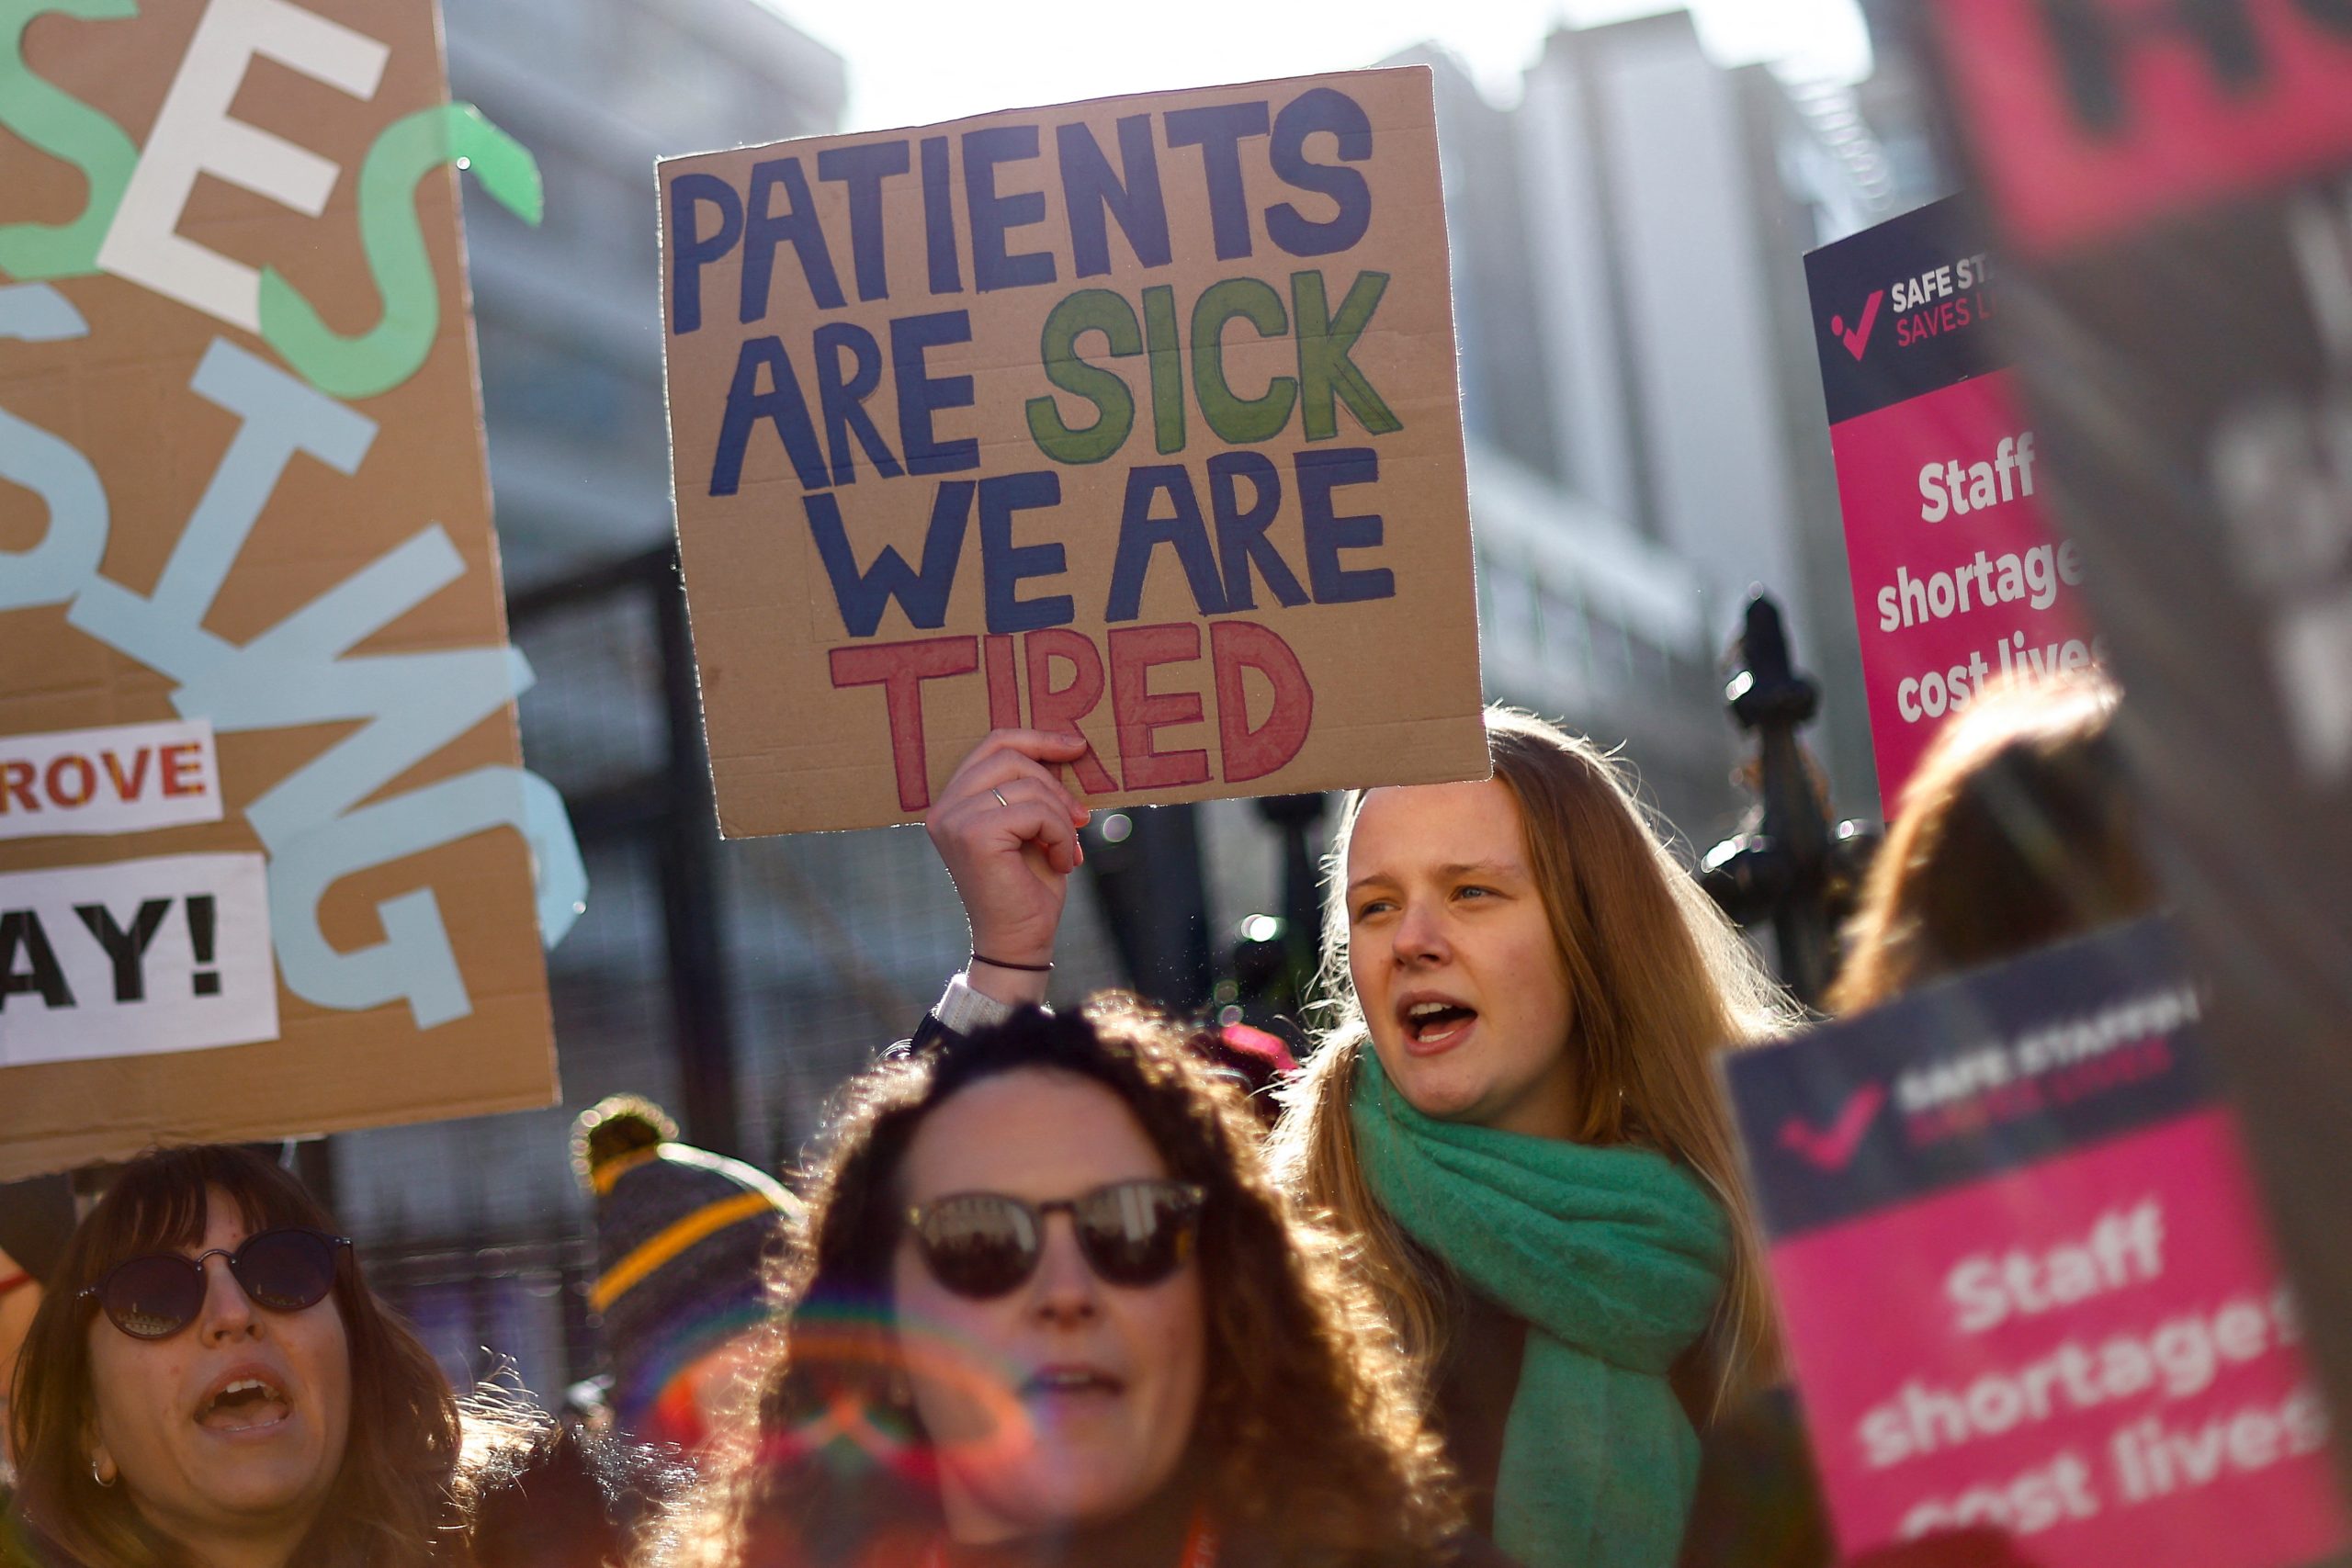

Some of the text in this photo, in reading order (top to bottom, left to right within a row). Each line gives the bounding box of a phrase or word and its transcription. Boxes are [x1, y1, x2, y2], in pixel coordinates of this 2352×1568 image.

[670, 87, 1373, 335] PATIENTS
[1891, 253, 1994, 313] SAFE ST
[1896, 298, 1971, 347] SAVES
[709, 269, 1404, 496] ARE SICK
[1918, 432, 2035, 524] Staff
[802, 446, 1396, 637] WE ARE
[829, 619, 1314, 812] TIRED
[1897, 650, 1989, 724] cost
[0, 741, 207, 816] ROVE
[0, 894, 223, 1011] AY!
[1947, 1198, 2163, 1334] Staff
